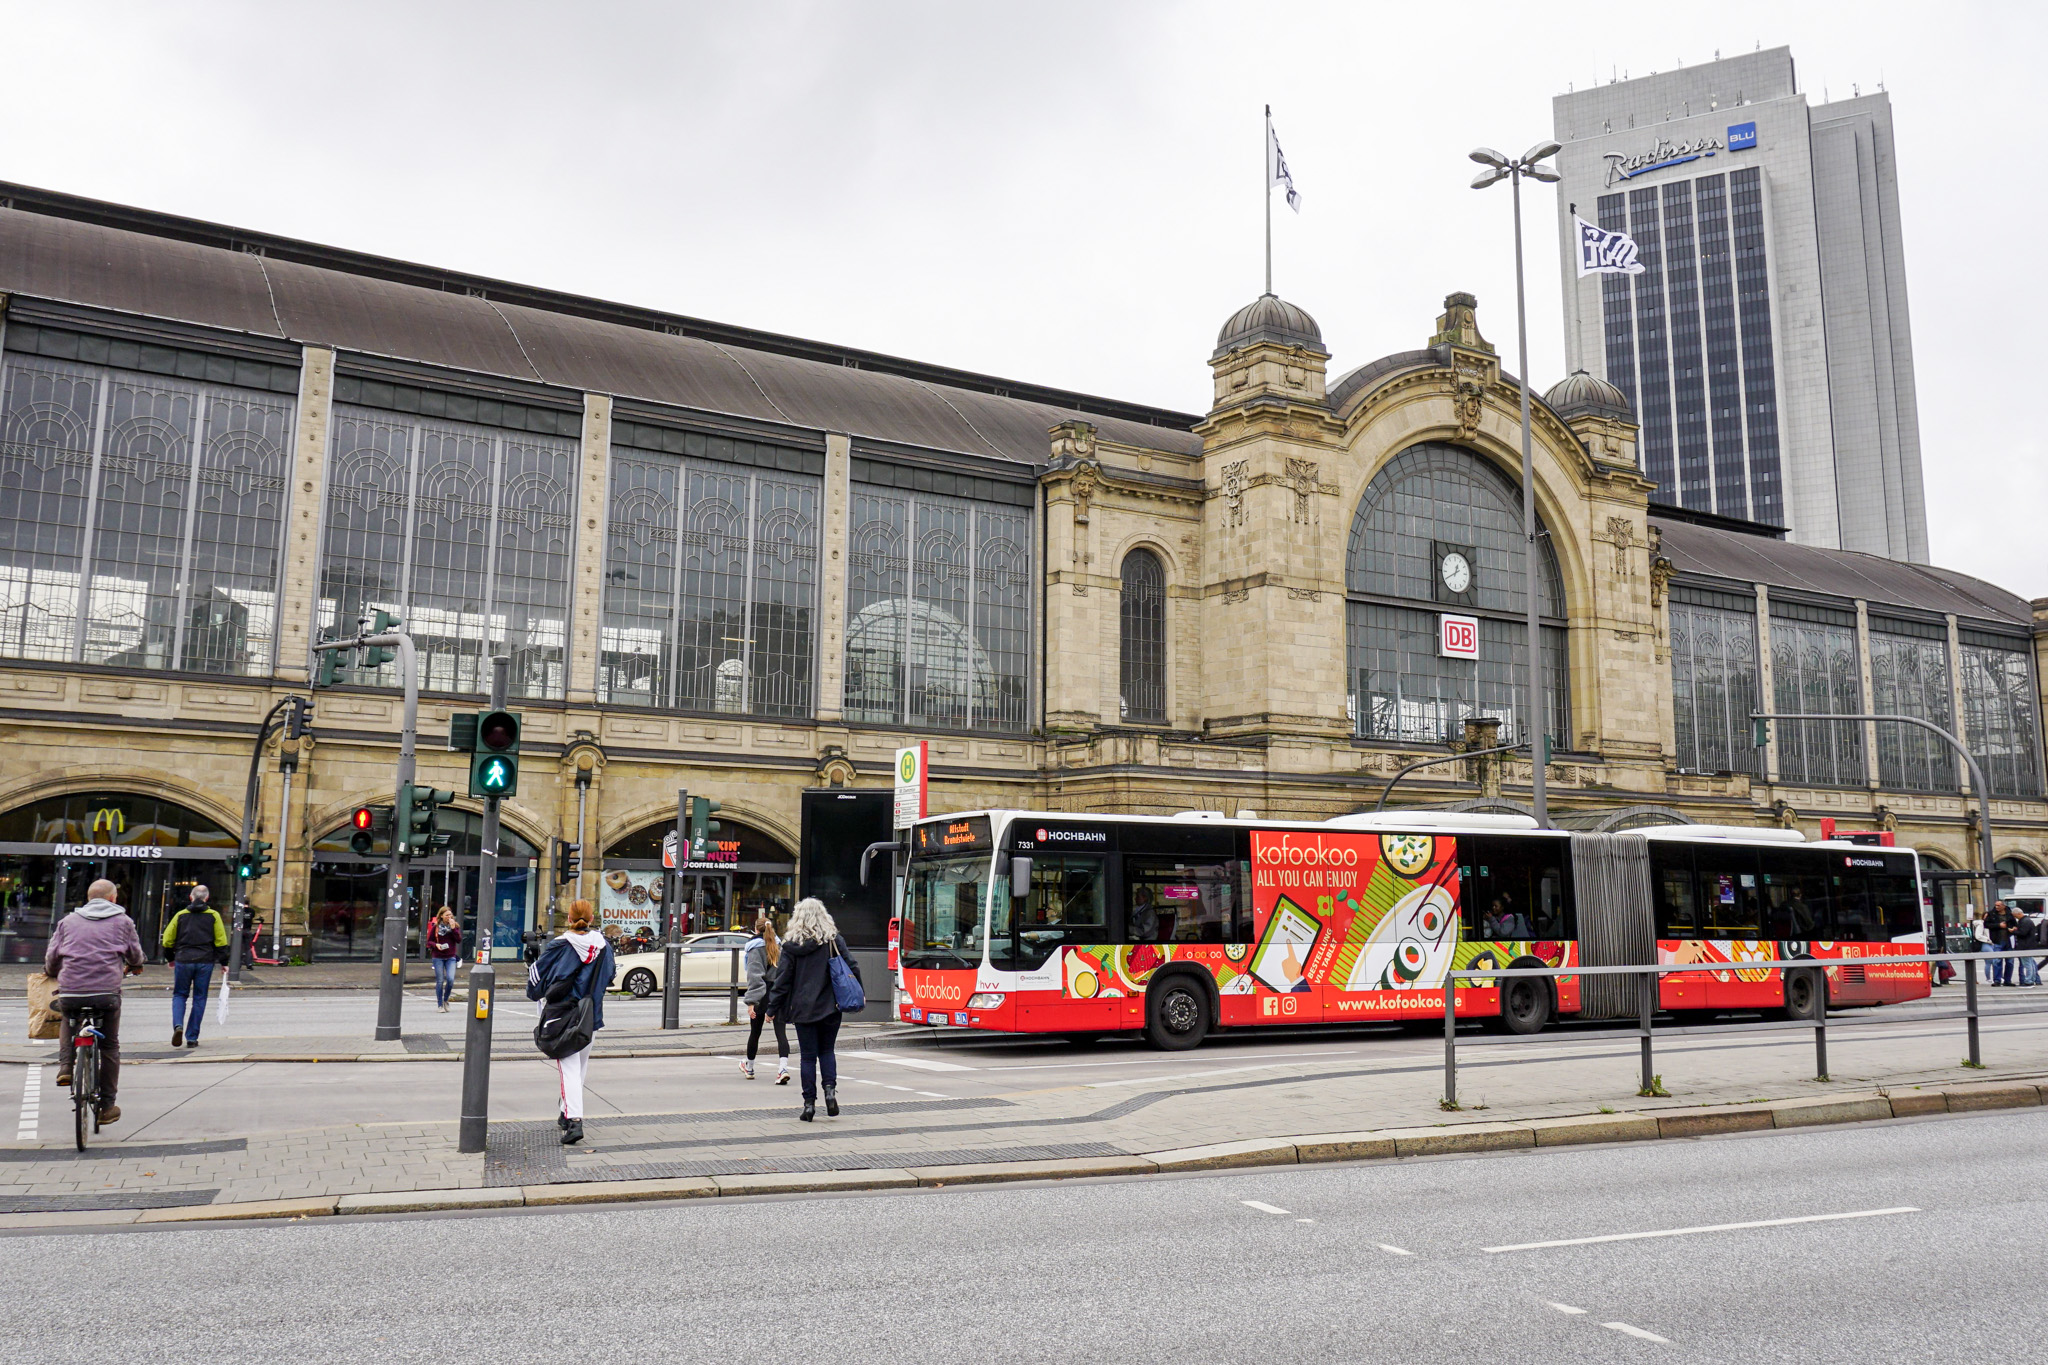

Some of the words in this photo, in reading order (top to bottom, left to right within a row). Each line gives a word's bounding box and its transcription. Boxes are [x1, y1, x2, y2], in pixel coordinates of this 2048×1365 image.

[1603, 136, 1724, 188] Radisson
[1729, 131, 1755, 142] BLU
[1449, 625, 1472, 648] DB
[920, 829, 927, 848] 4
[1048, 831, 1106, 842] HOCHBAHN
[54, 843, 162, 858] McDonald's
[1018, 841, 1034, 849] 7331
[1256, 833, 1358, 867] kofookoo
[688, 861, 714, 869] COFFEE
[1851, 858, 1884, 868] HOCHBAHN
[1257, 869, 1276, 887] ALL
[1277, 870, 1302, 887] YOU
[1302, 870, 1326, 887] CAN
[1326, 871, 1358, 888] ENJOY
[603, 908, 652, 920] DUNKIN'
[1183, 946, 1222, 959] kofookoo
[1307, 927, 1333, 980] BESTELLUNG
[1314, 969, 1326, 984] VIA
[1321, 938, 1338, 968] TABLET
[1868, 969, 1924, 979] www.kofookoo.de
[915, 975, 961, 1001] kofookoo
[979, 980, 1000, 990] hvv
[1337, 993, 1462, 1011] www.kofookoo.e
